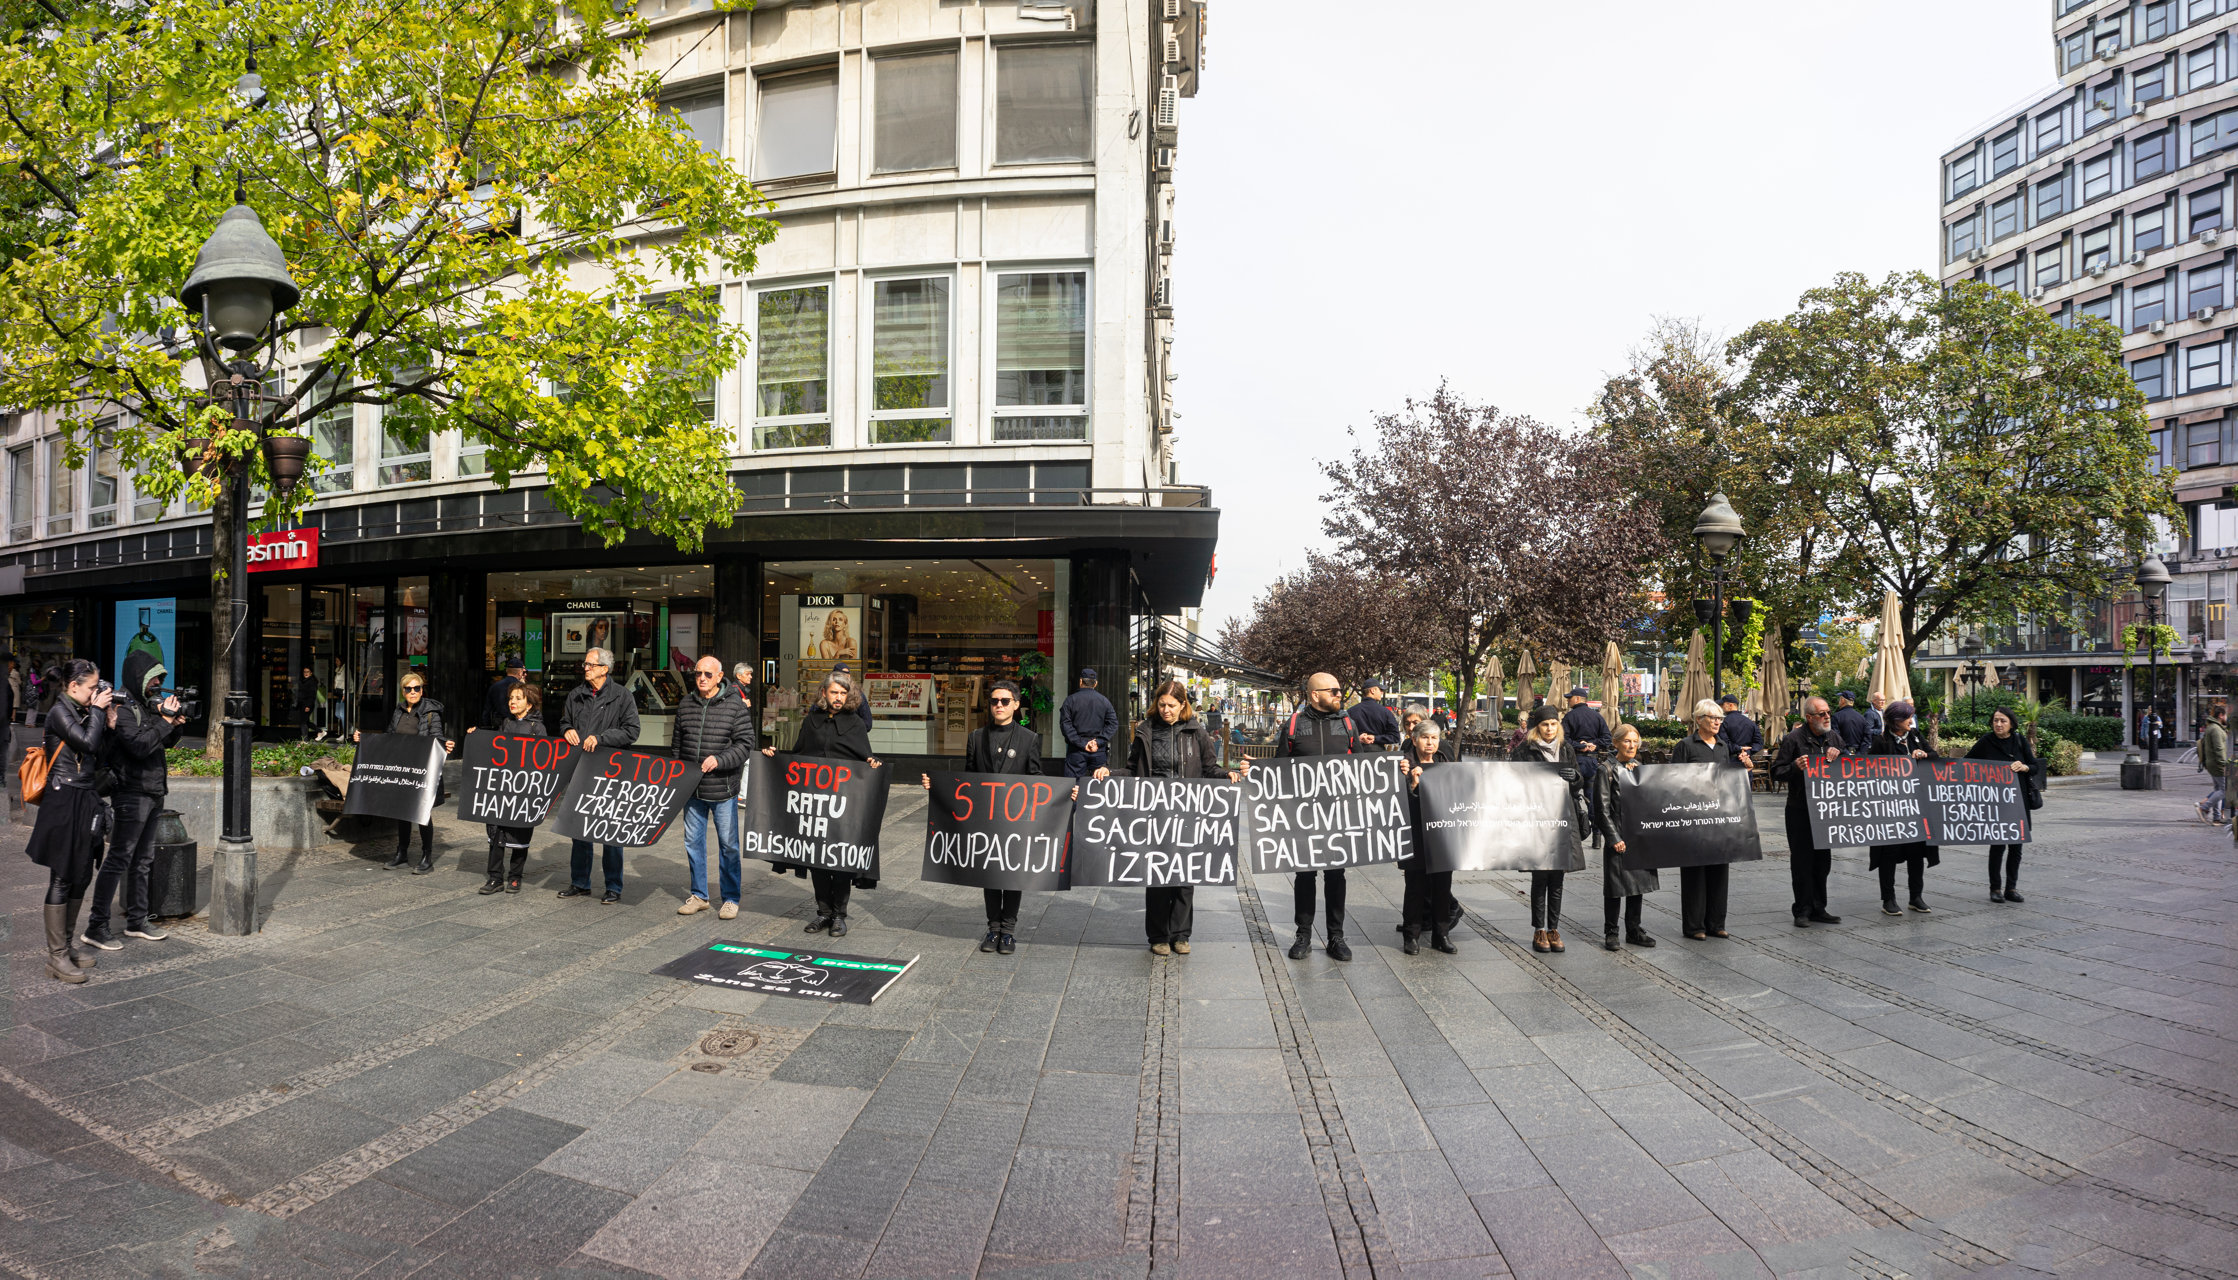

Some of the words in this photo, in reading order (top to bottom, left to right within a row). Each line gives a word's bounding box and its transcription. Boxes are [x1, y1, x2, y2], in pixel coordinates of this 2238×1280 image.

[566, 601, 601, 609] CHANEL
[806, 595, 835, 606] DIOR
[491, 735, 571, 770] STOP
[604, 751, 685, 787] STOP
[786, 761, 852, 793] STOP
[1247, 755, 1404, 801] SOLIDARNOST
[1806, 756, 1831, 779] WE
[1841, 757, 1914, 779] DEMAND
[1931, 761, 1958, 782] WE
[1962, 761, 2014, 785] DEMAND
[473, 766, 559, 796] TERORU
[594, 776, 676, 806] TERORU
[1811, 778, 1900, 799] LIBERATION
[1902, 778, 1921, 794] OF
[786, 790, 847, 819] RATU
[952, 780, 1053, 822] STOP
[1083, 777, 1242, 818] SOLIDARNOST
[1928, 784, 1999, 803] LIBERATION
[2002, 786, 2017, 804] OF
[574, 793, 670, 824] IZRAELSKE
[1254, 803, 1291, 833] SA
[1296, 794, 1406, 831] CIVILIMA
[1661, 803, 1682, 813] حماس
[1816, 798, 1921, 820] PALESTINIAN
[1942, 803, 2000, 822] ISRAELI
[798, 814, 828, 838] NA
[1085, 815, 1128, 845] SA
[1128, 814, 1235, 847] CIVILIMA
[1640, 820, 1664, 830] ישראל
[1665, 819, 1680, 828] צבא
[1681, 818, 1692, 827] של
[745, 831, 816, 864] BLISKOM
[820, 841, 875, 870] ISTOKU
[1256, 825, 1414, 871] PALESTINE
[1108, 846, 1235, 886] IZRAELA
[721, 945, 763, 955] mir
[821, 959, 903, 972] pravda
[761, 984, 791, 992] za
[797, 988, 844, 999] mir
